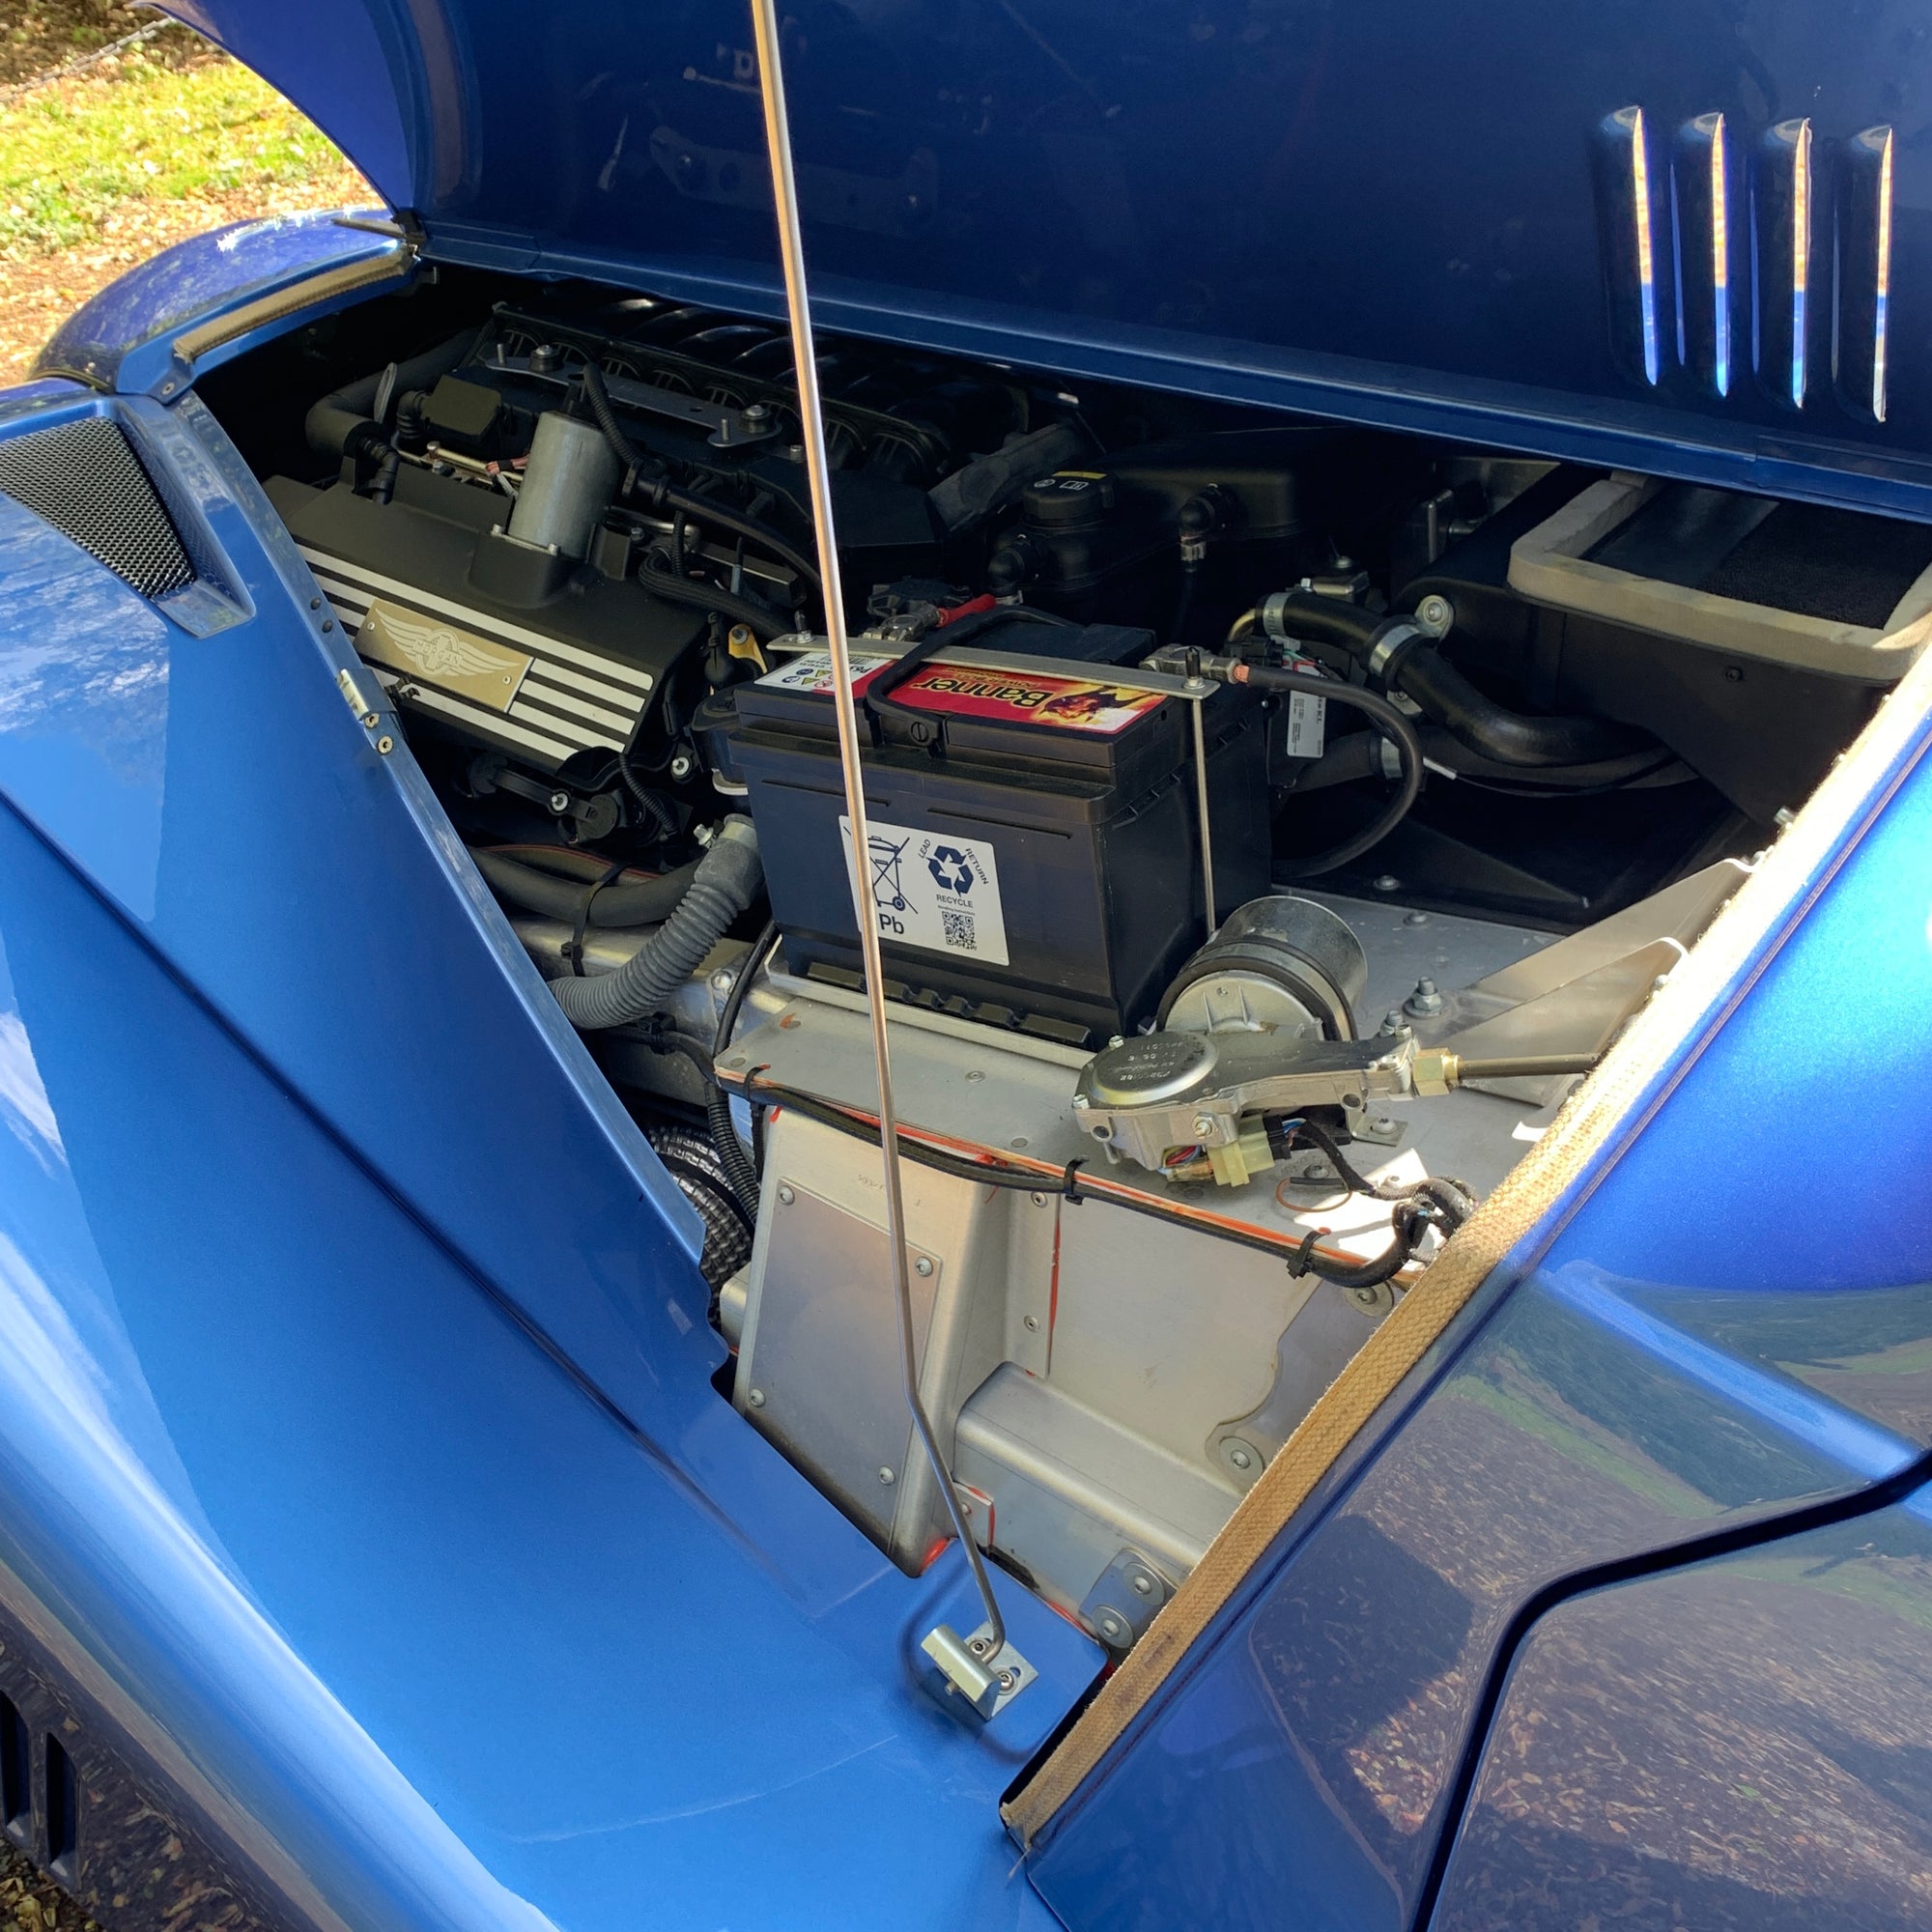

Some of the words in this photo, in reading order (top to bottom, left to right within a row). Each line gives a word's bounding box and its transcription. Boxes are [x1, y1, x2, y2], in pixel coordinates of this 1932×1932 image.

[415, 640, 460, 665] MORGAN
[914, 678, 1054, 707] Banner
[918, 838, 931, 859] LEAD
[965, 848, 989, 885] RETURN
[936, 894, 974, 908] RECYCLE
[879, 913, 904, 934] Pb
